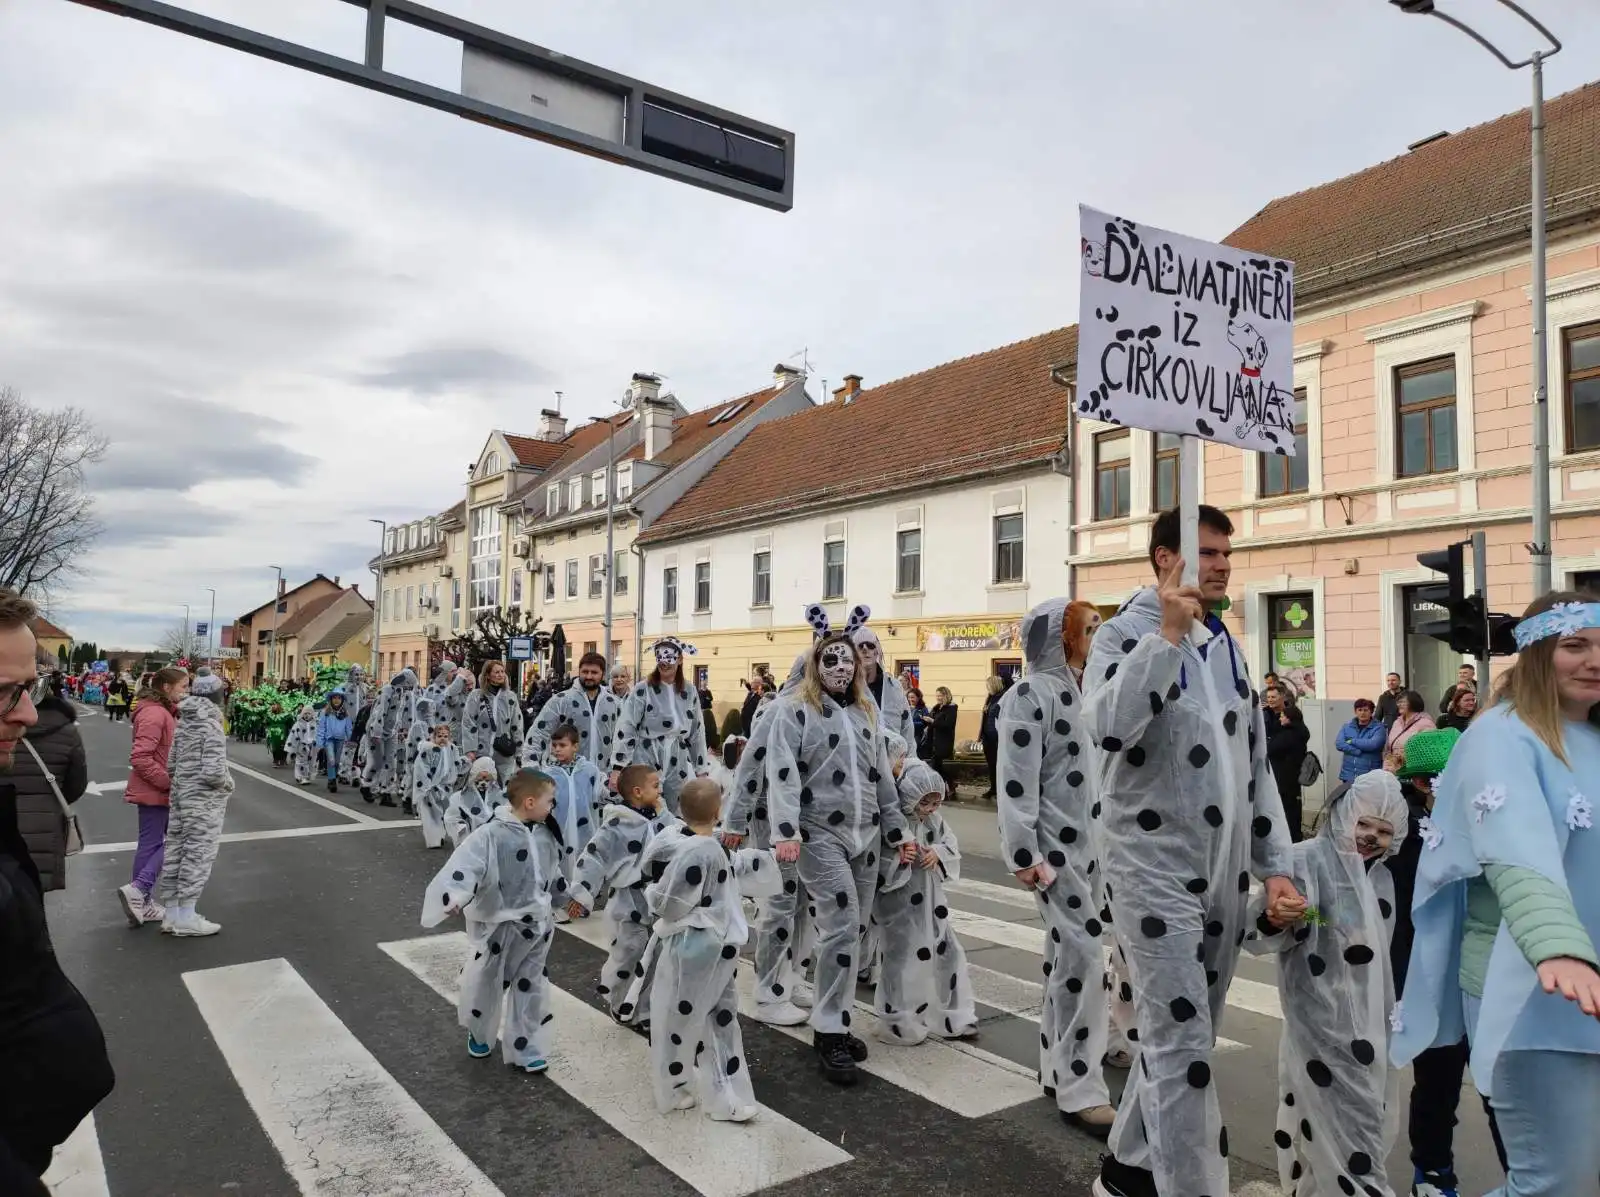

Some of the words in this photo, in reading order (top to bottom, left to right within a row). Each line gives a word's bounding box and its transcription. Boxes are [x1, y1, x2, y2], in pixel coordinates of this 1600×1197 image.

[1103, 232, 1292, 323] DALMATINERI
[1100, 341, 1287, 431] CIRKOVLJANA
[949, 639, 969, 648] OPEN
[970, 639, 986, 648] 0-24
